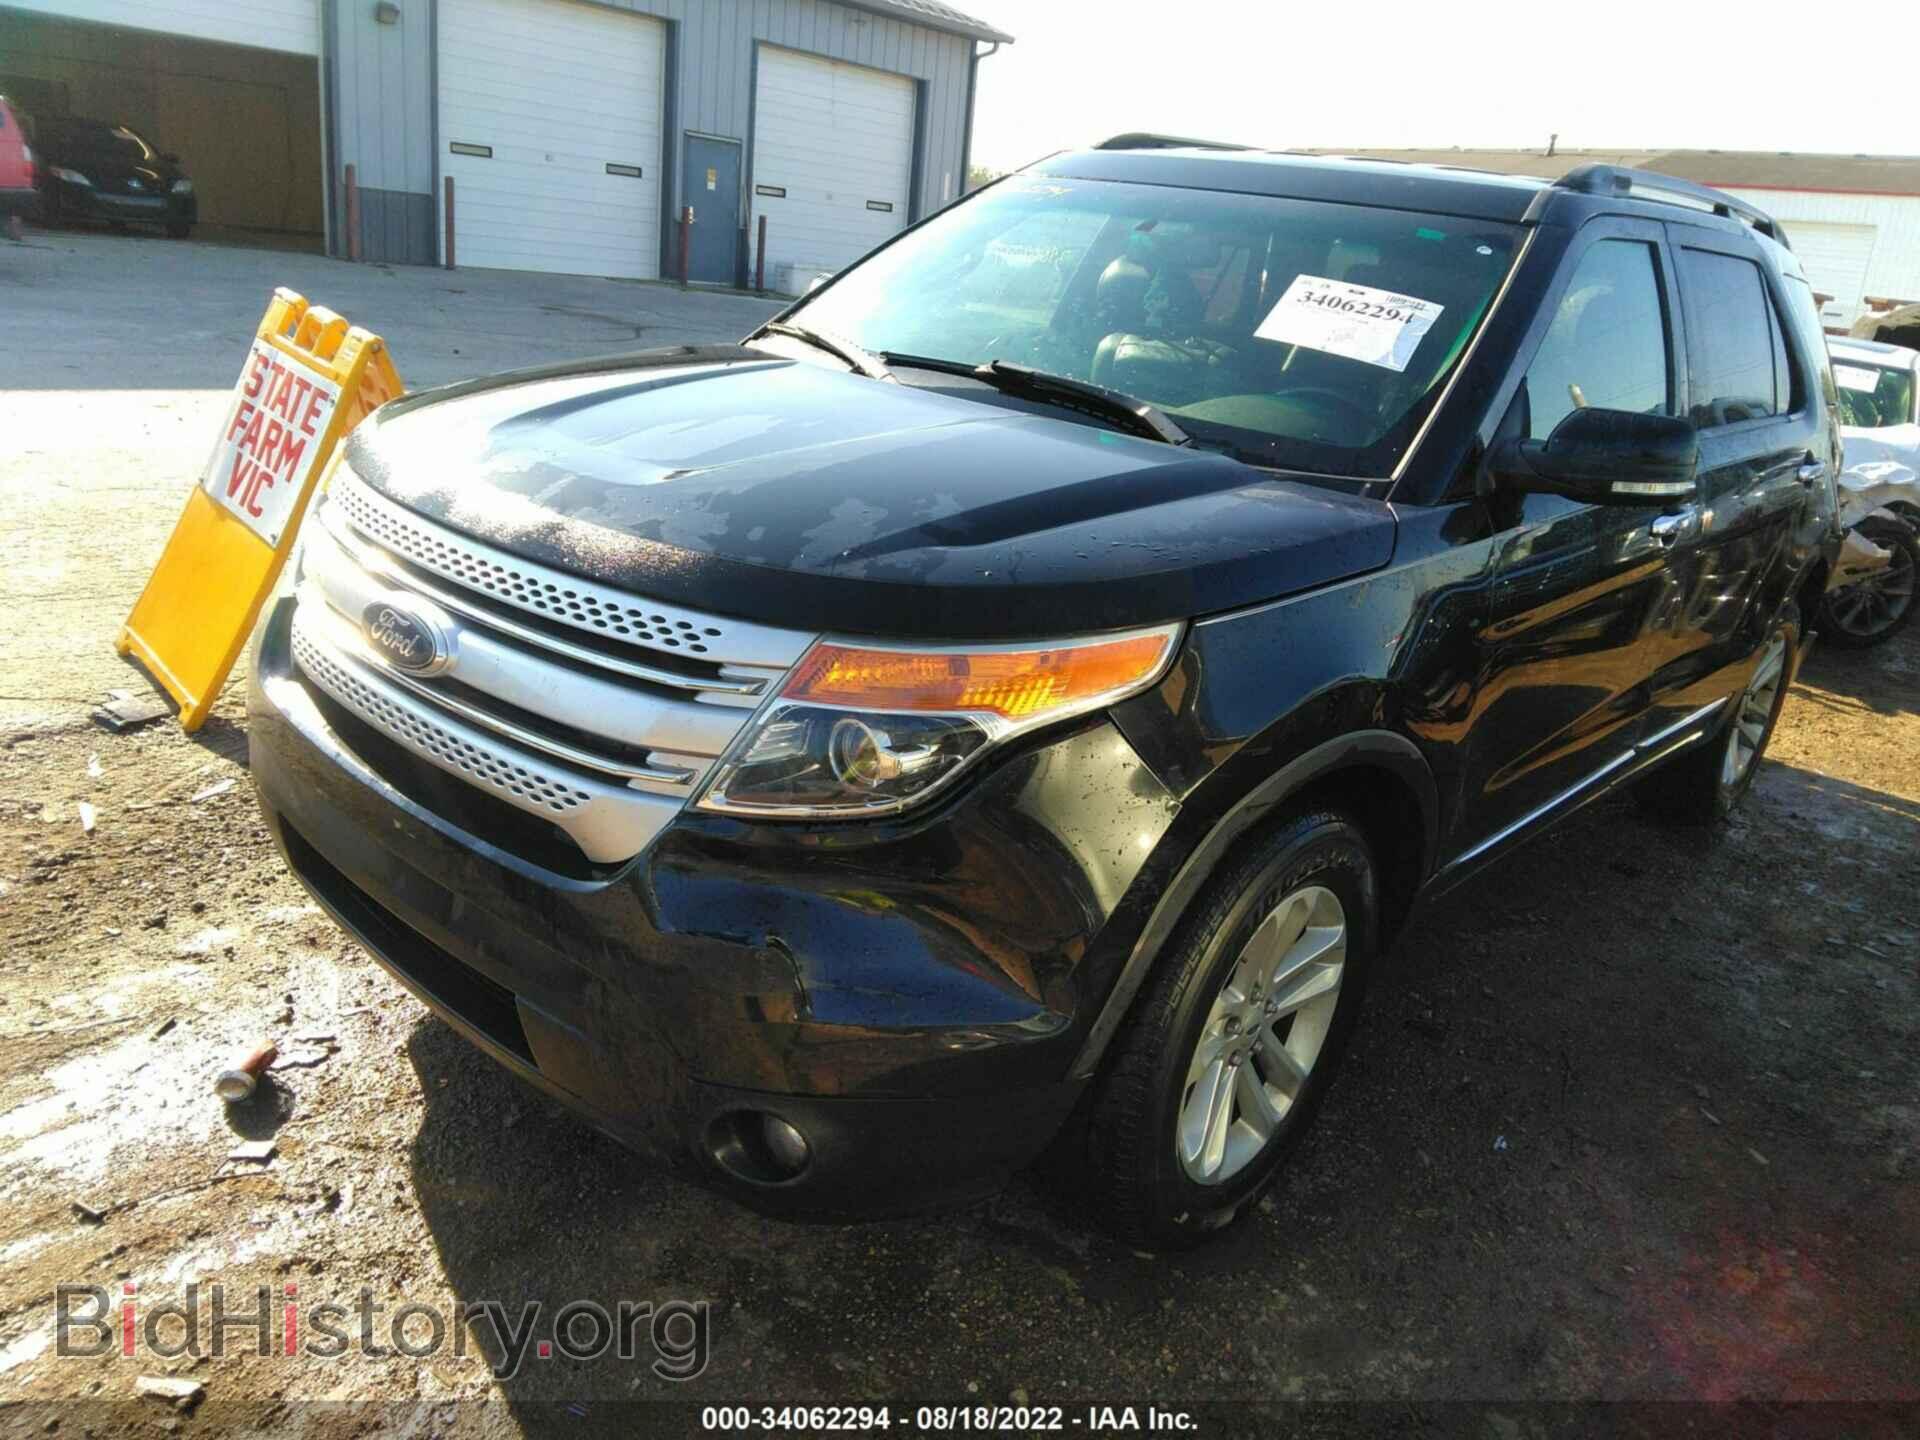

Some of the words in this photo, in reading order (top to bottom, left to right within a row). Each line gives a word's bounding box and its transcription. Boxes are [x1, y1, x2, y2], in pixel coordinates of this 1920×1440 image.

[1297, 291, 1416, 325] 34062294
[244, 354, 330, 437] STATE
[227, 399, 306, 483] FARM
[226, 451, 274, 518] VIC
[371, 608, 420, 656] Ford
